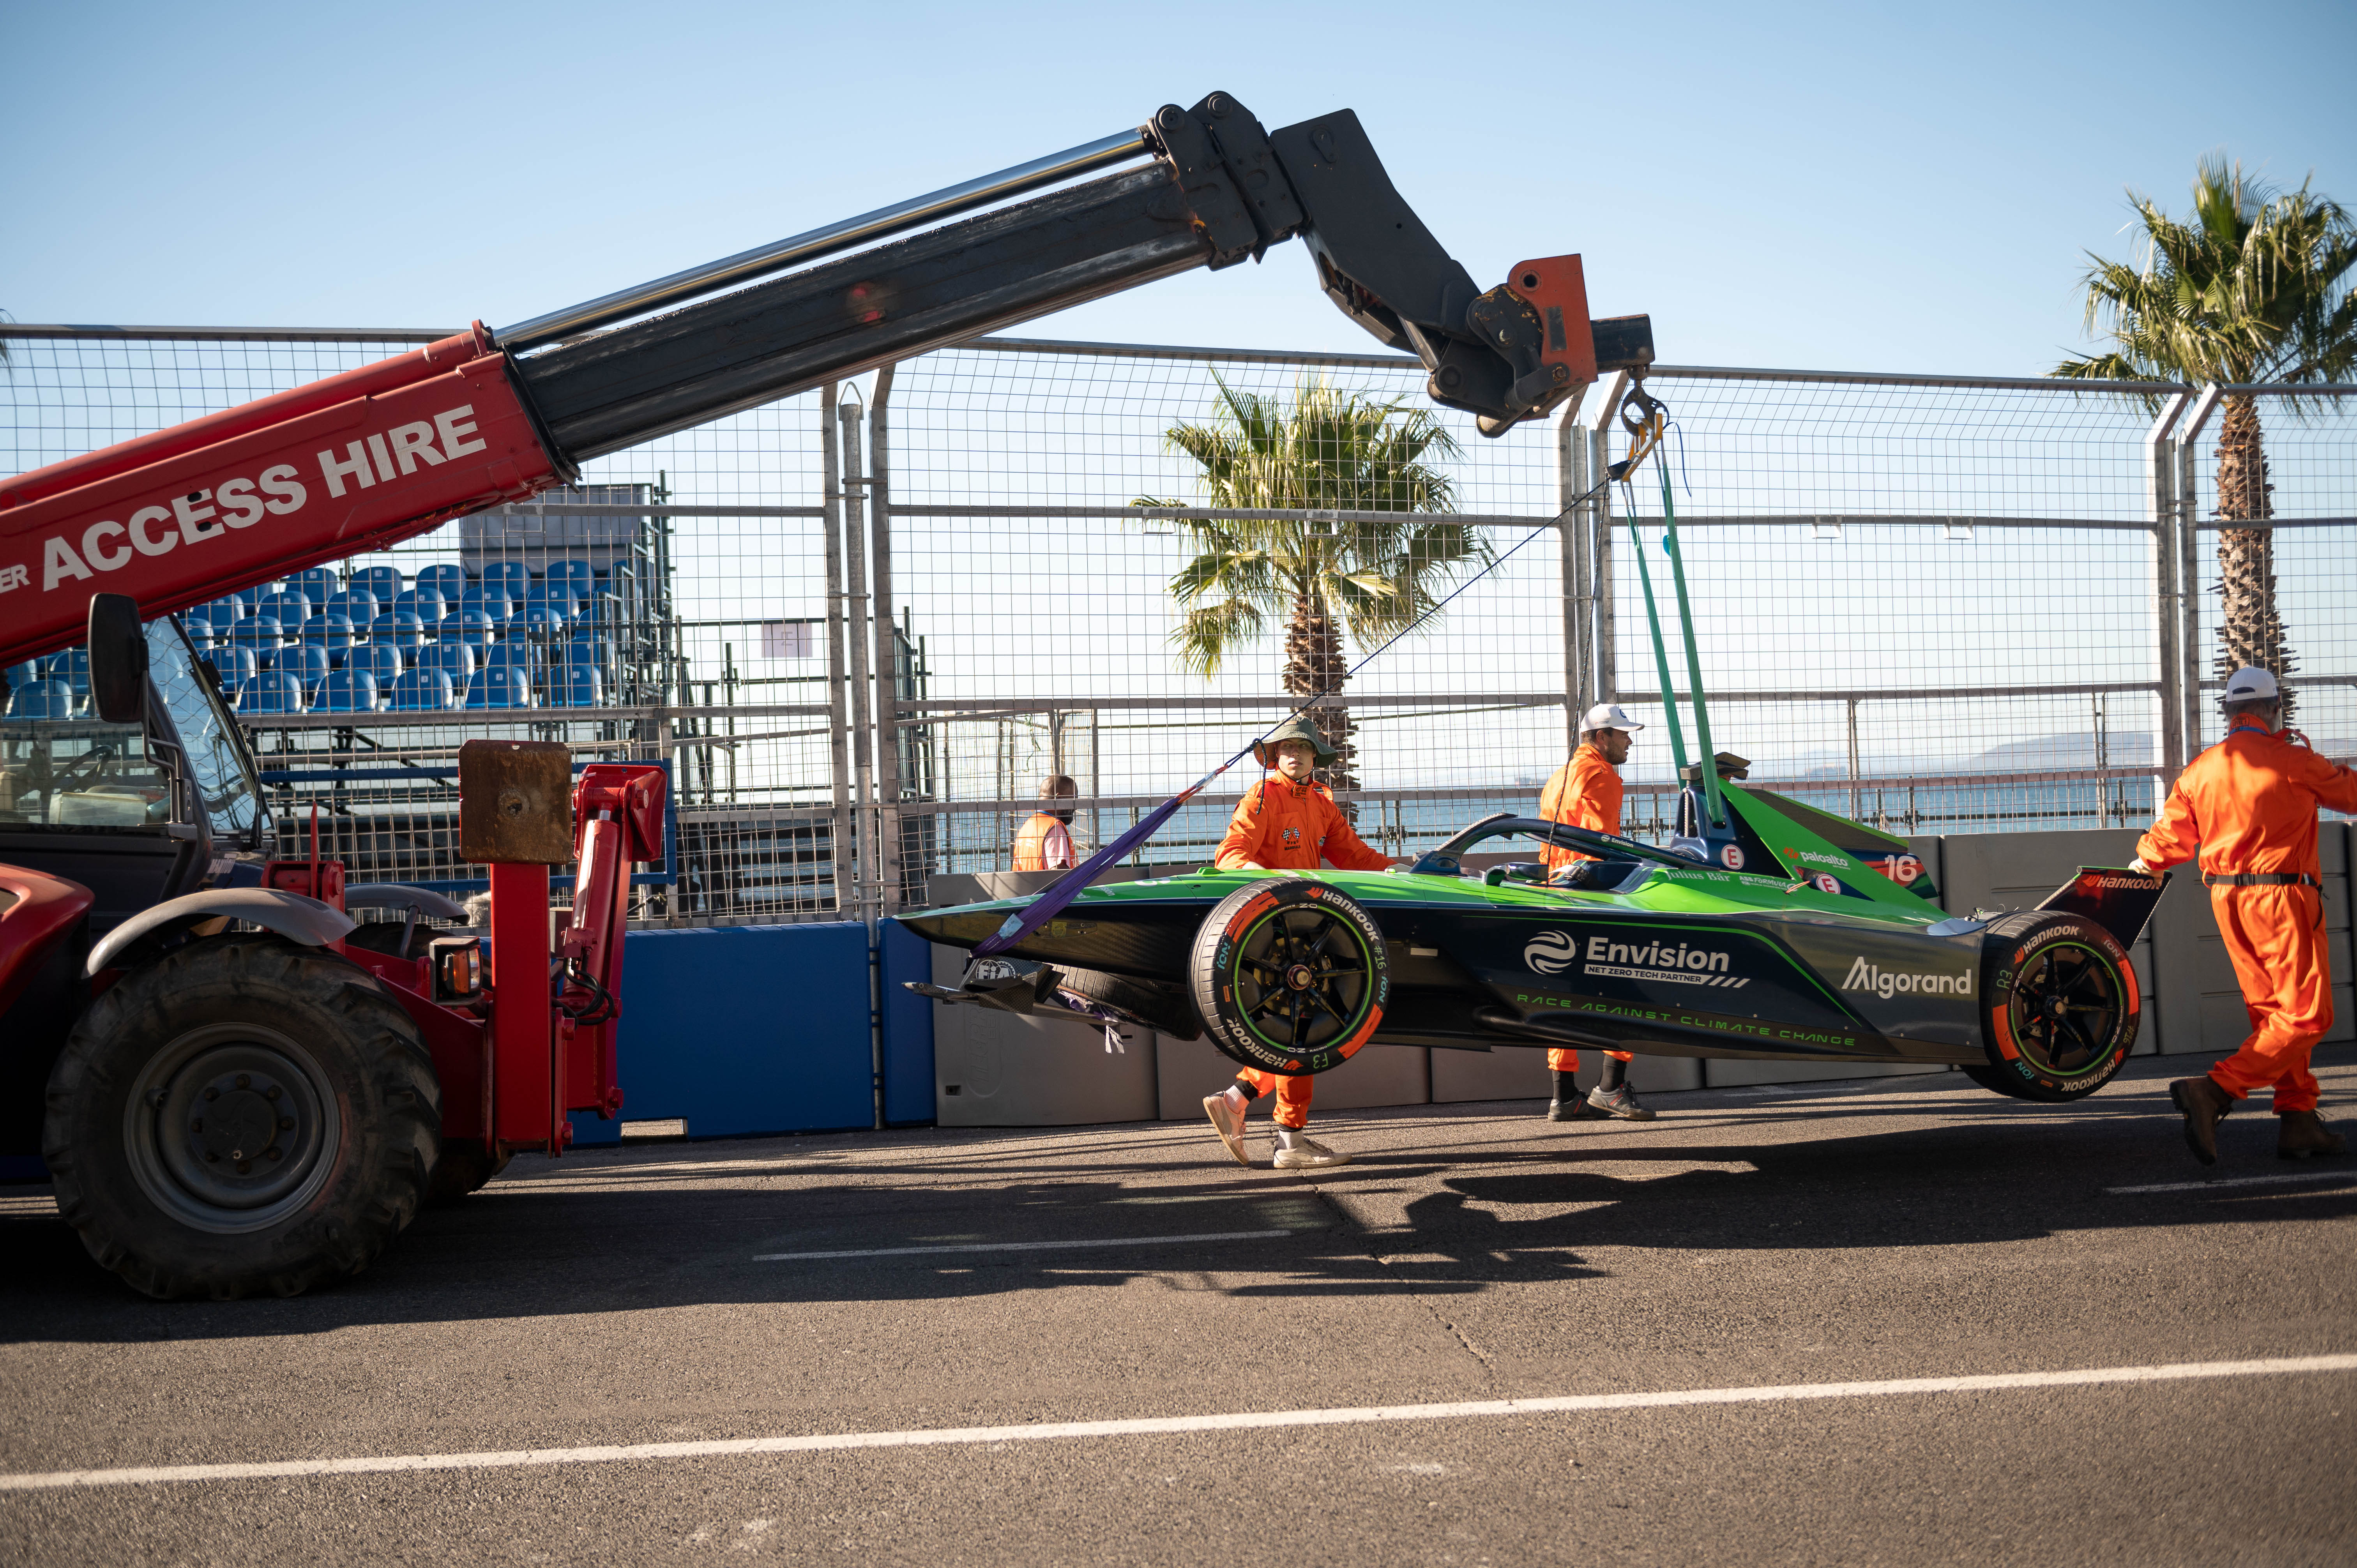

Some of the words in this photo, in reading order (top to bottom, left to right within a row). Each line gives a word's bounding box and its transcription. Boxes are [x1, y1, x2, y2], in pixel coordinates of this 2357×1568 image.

[42, 464, 307, 592] ACCESS
[317, 404, 487, 498] HIRE
[1611, 838, 1634, 848] Envision
[1727, 849, 1739, 866] E
[1800, 852, 1848, 866] paloalto
[1665, 871, 1704, 880] Julius
[1706, 872, 1730, 881] Bär
[1885, 855, 1917, 881] 16
[1754, 877, 1787, 887] FORMULA
[1822, 878, 1836, 893] E
[1374, 945, 1387, 969] #16
[1587, 937, 1729, 972] Envision
[1608, 968, 1632, 976] ZERO
[1634, 970, 1658, 979] TECH
[1661, 972, 1701, 983] PARTNER
[1842, 956, 1971, 999] Algorand
[1997, 969, 2012, 990] R3
[1518, 994, 1572, 1008] RACE
[1581, 1003, 1671, 1021] AGAINST
[1680, 1016, 1770, 1035] CLIMATE
[1779, 1030, 1855, 1046] CHANGE
[2123, 1025, 2135, 1045] #16
[1313, 1052, 1329, 1069] F3
